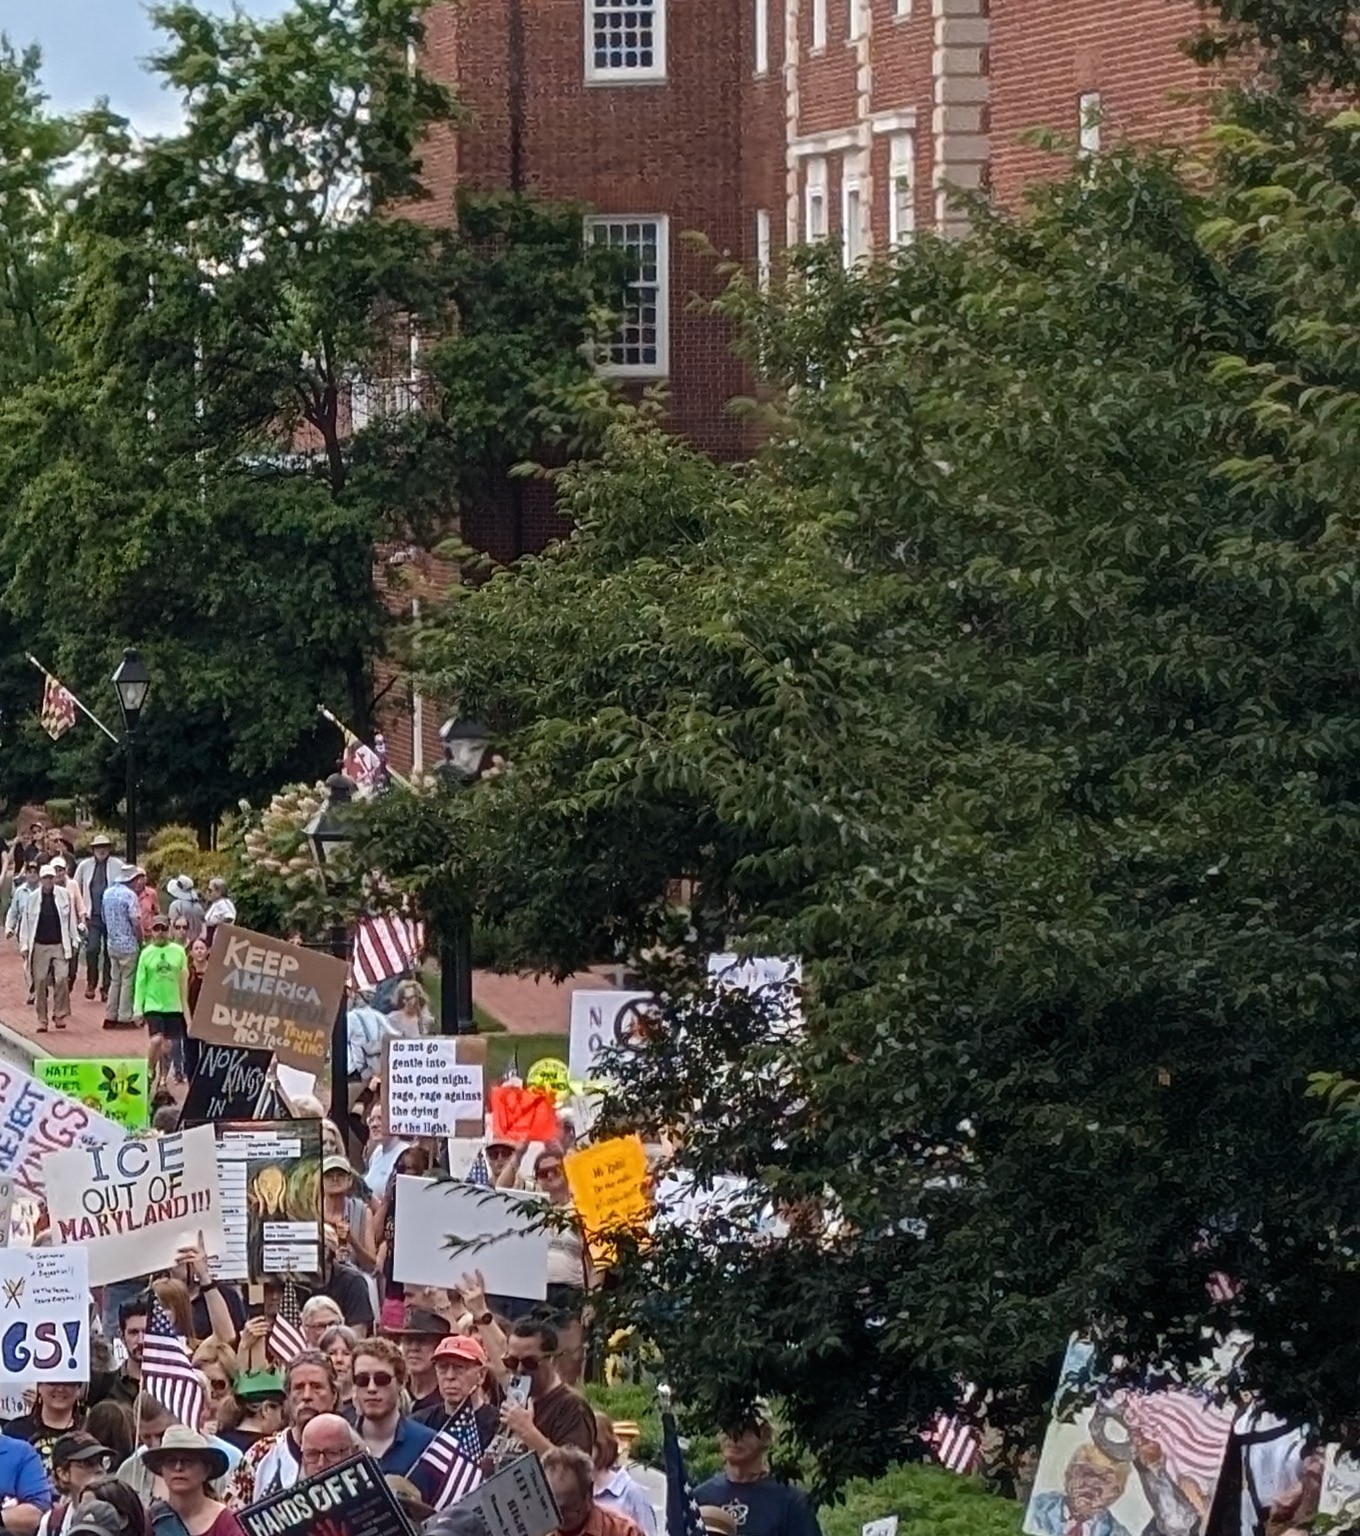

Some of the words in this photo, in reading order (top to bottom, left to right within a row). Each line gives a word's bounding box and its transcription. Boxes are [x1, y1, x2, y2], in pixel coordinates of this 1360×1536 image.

[222, 935, 299, 978] KEEP
[222, 969, 321, 1005] AMERICA
[211, 1004, 280, 1034] DUMP
[283, 1018, 326, 1042] TRUMP
[233, 1029, 260, 1043] NO
[292, 1039, 325, 1058] KING
[392, 1042, 403, 1052] do
[406, 1042, 424, 1052] not
[426, 1043, 439, 1054] go
[45, 1065, 80, 1076] HATE
[200, 1049, 231, 1078] NO
[392, 1058, 423, 1069] gentle
[425, 1058, 446, 1068] into
[392, 1074, 413, 1085] that
[416, 1074, 439, 1087] good
[442, 1074, 473, 1086] night.
[208, 1097, 226, 1119] IN
[392, 1092, 417, 1103] rage,
[420, 1092, 442, 1103] rage
[444, 1090, 481, 1103] against
[392, 1105, 408, 1116] the
[411, 1105, 439, 1119] dying
[392, 1123, 403, 1133] of
[405, 1122, 421, 1133] the
[423, 1122, 450, 1135] light.
[13, 1100, 90, 1199] KINGS
[86, 1133, 185, 1181] ICE
[83, 1182, 137, 1214] OUT
[149, 1170, 184, 1203] OF
[57, 1189, 211, 1244] MARYLAND!!!
[307, 1462, 376, 1513] OFF!
